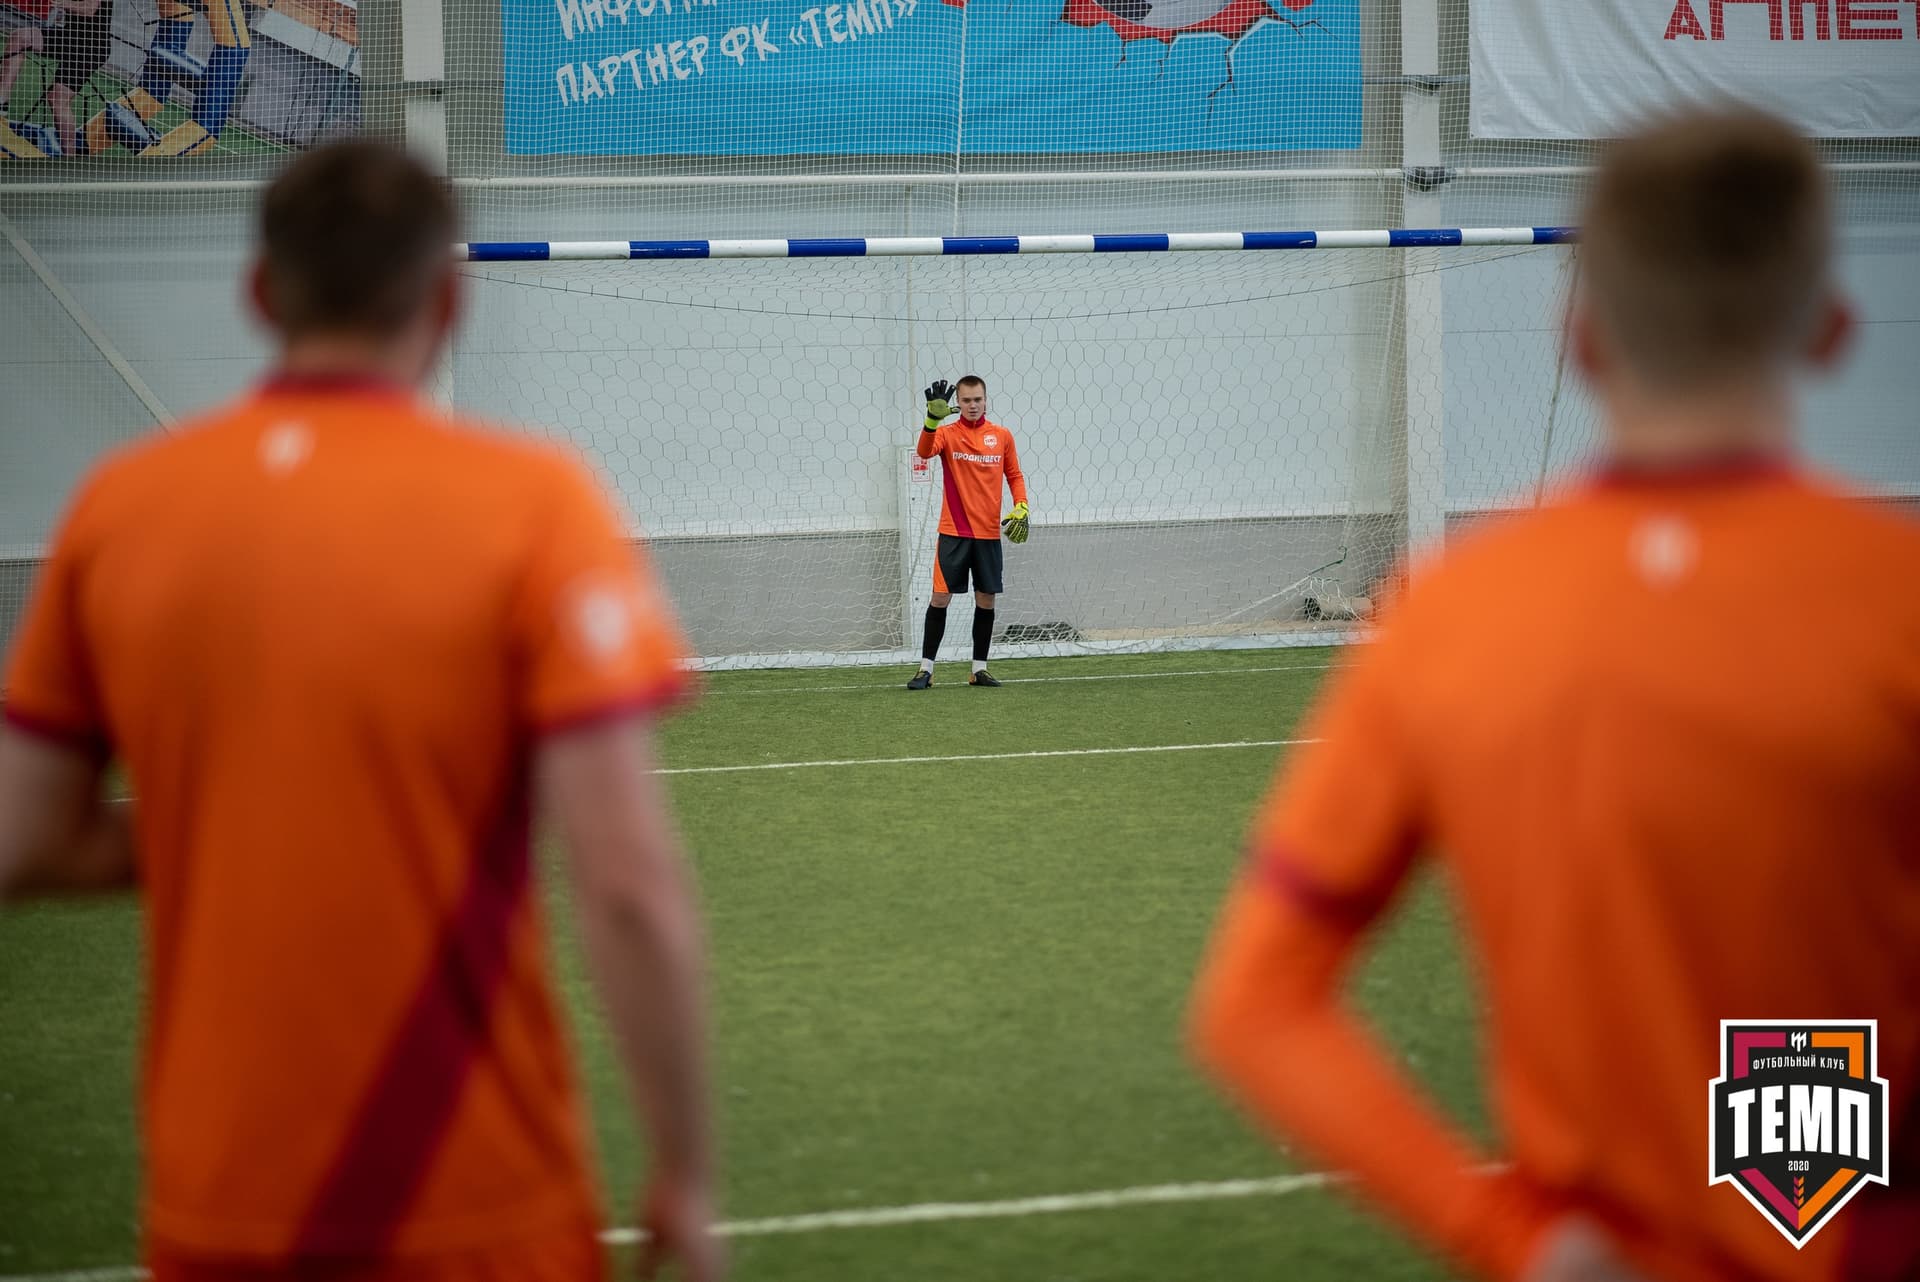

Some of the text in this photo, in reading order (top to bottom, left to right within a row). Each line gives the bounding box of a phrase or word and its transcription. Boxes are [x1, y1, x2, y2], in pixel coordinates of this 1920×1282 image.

[1663, 0, 1920, 41] АППЕ
[556, 0, 918, 107] ПАРТНЕР ФК «ТЕМП»
[952, 451, 1002, 464] ПРОДИНВЕСТ
